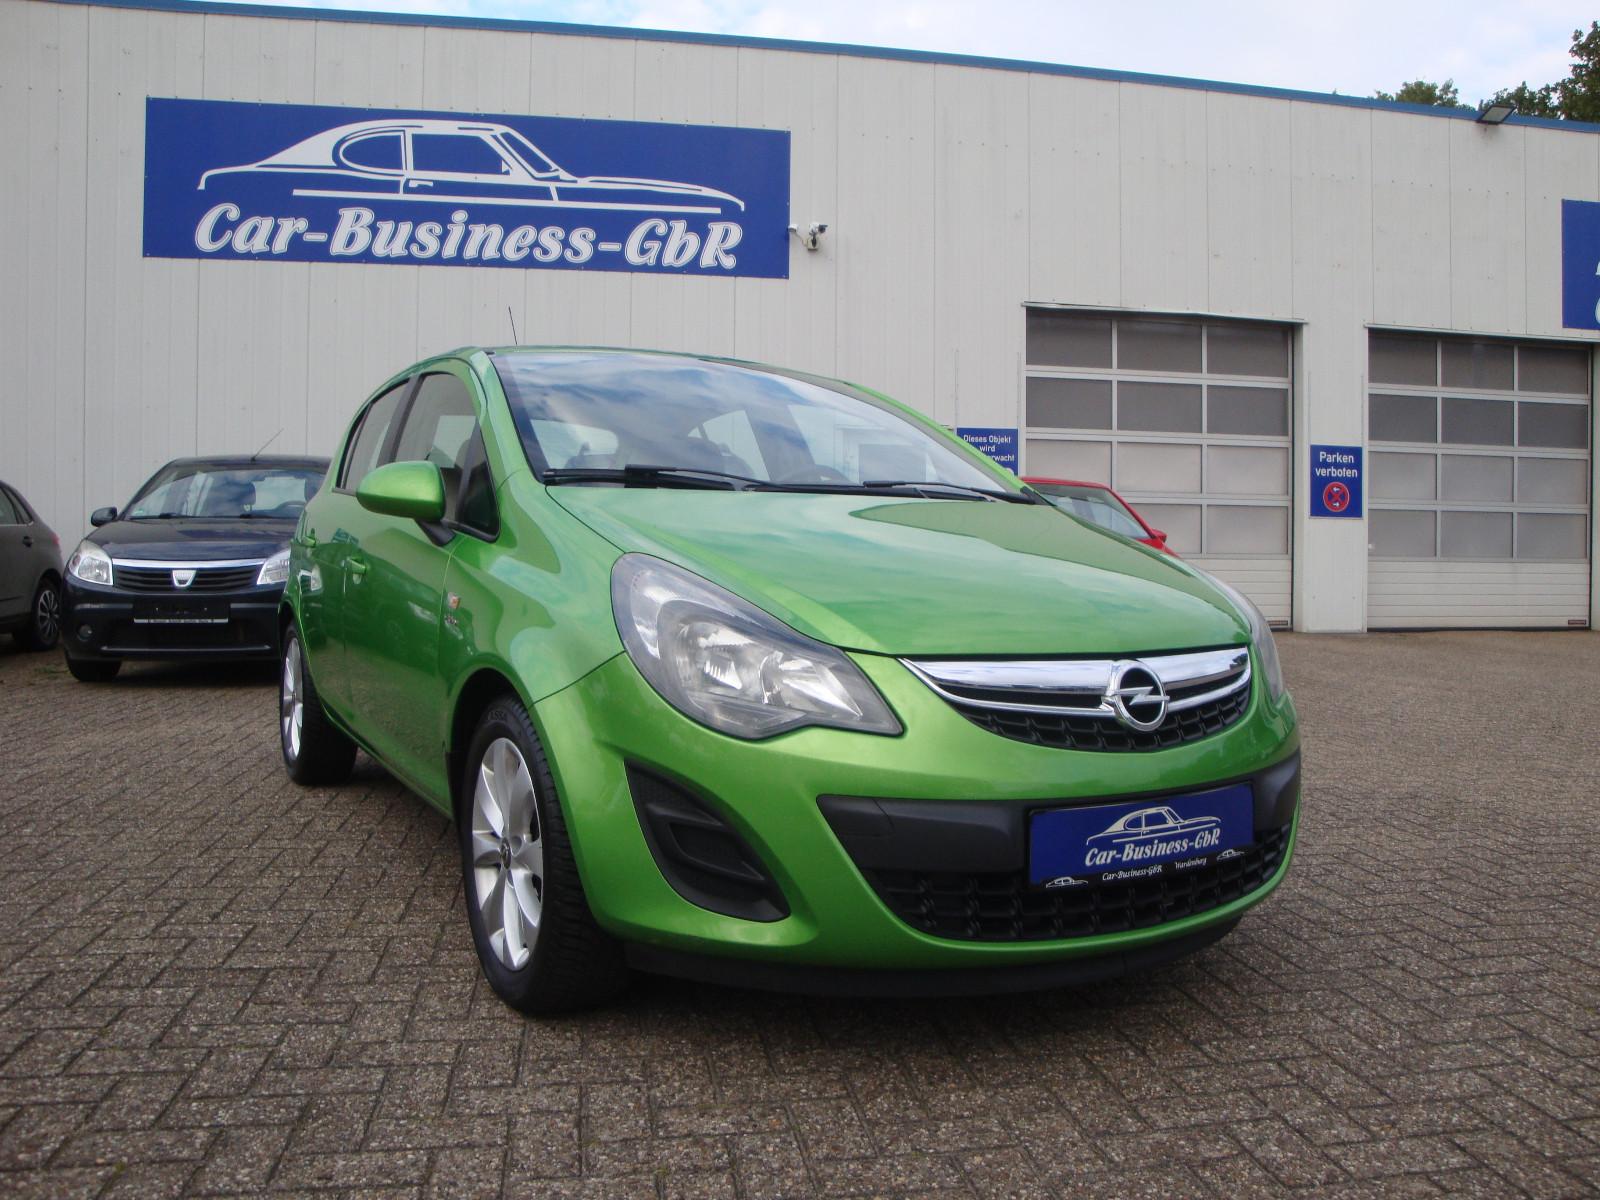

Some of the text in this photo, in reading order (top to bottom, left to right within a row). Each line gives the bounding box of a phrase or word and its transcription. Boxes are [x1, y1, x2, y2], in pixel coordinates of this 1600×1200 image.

[195, 203, 743, 268] Car-Business-GbR
[963, 434, 1011, 444] Dieses Objekt
[979, 444, 996, 453] wird
[1319, 451, 1354, 463] Parken
[1315, 466, 1358, 478] verboten
[1085, 828, 1221, 867] Car-Business-GbR
